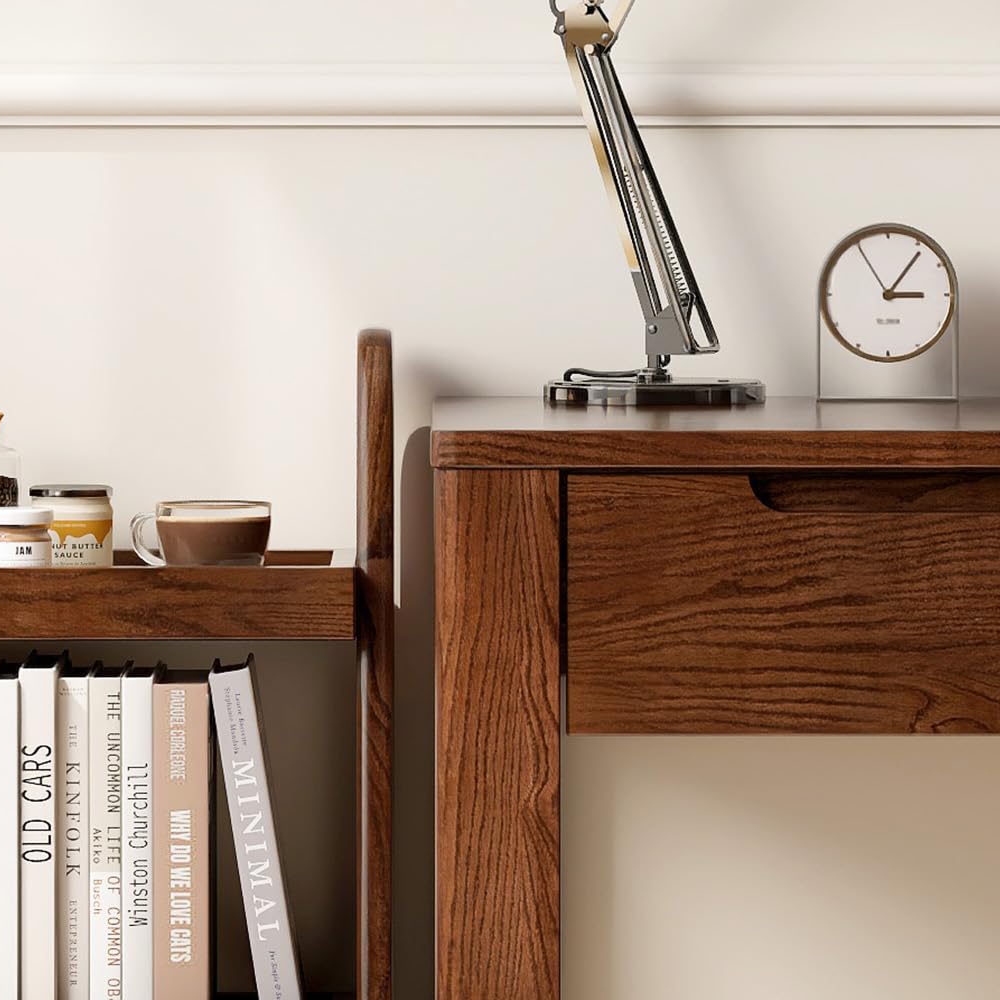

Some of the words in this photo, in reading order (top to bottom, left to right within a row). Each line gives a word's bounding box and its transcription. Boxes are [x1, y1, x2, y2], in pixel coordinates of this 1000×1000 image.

[15, 546, 32, 555] JAM
[107, 692, 120, 720] THE
[69, 725, 78, 748] THE
[22, 744, 52, 802] CARS
[107, 732, 120, 814] UNCOMMON
[66, 762, 80, 876] KINFOLK
[128, 763, 148, 849] Churchill
[22, 819, 52, 862] OLD
[170, 810, 191, 841] WHY
[107, 826, 120, 864] LIFE
[170, 845, 191, 862] DO
[232, 758, 280, 941] MINIMAL
[107, 876, 120, 895] OF
[128, 859, 148, 926] Winston
[170, 867, 191, 888] WE
[93, 879, 102, 916] Busch
[170, 892, 191, 925] LOVE
[107, 907, 120, 966] COMMON
[170, 928, 192, 962] CATS
